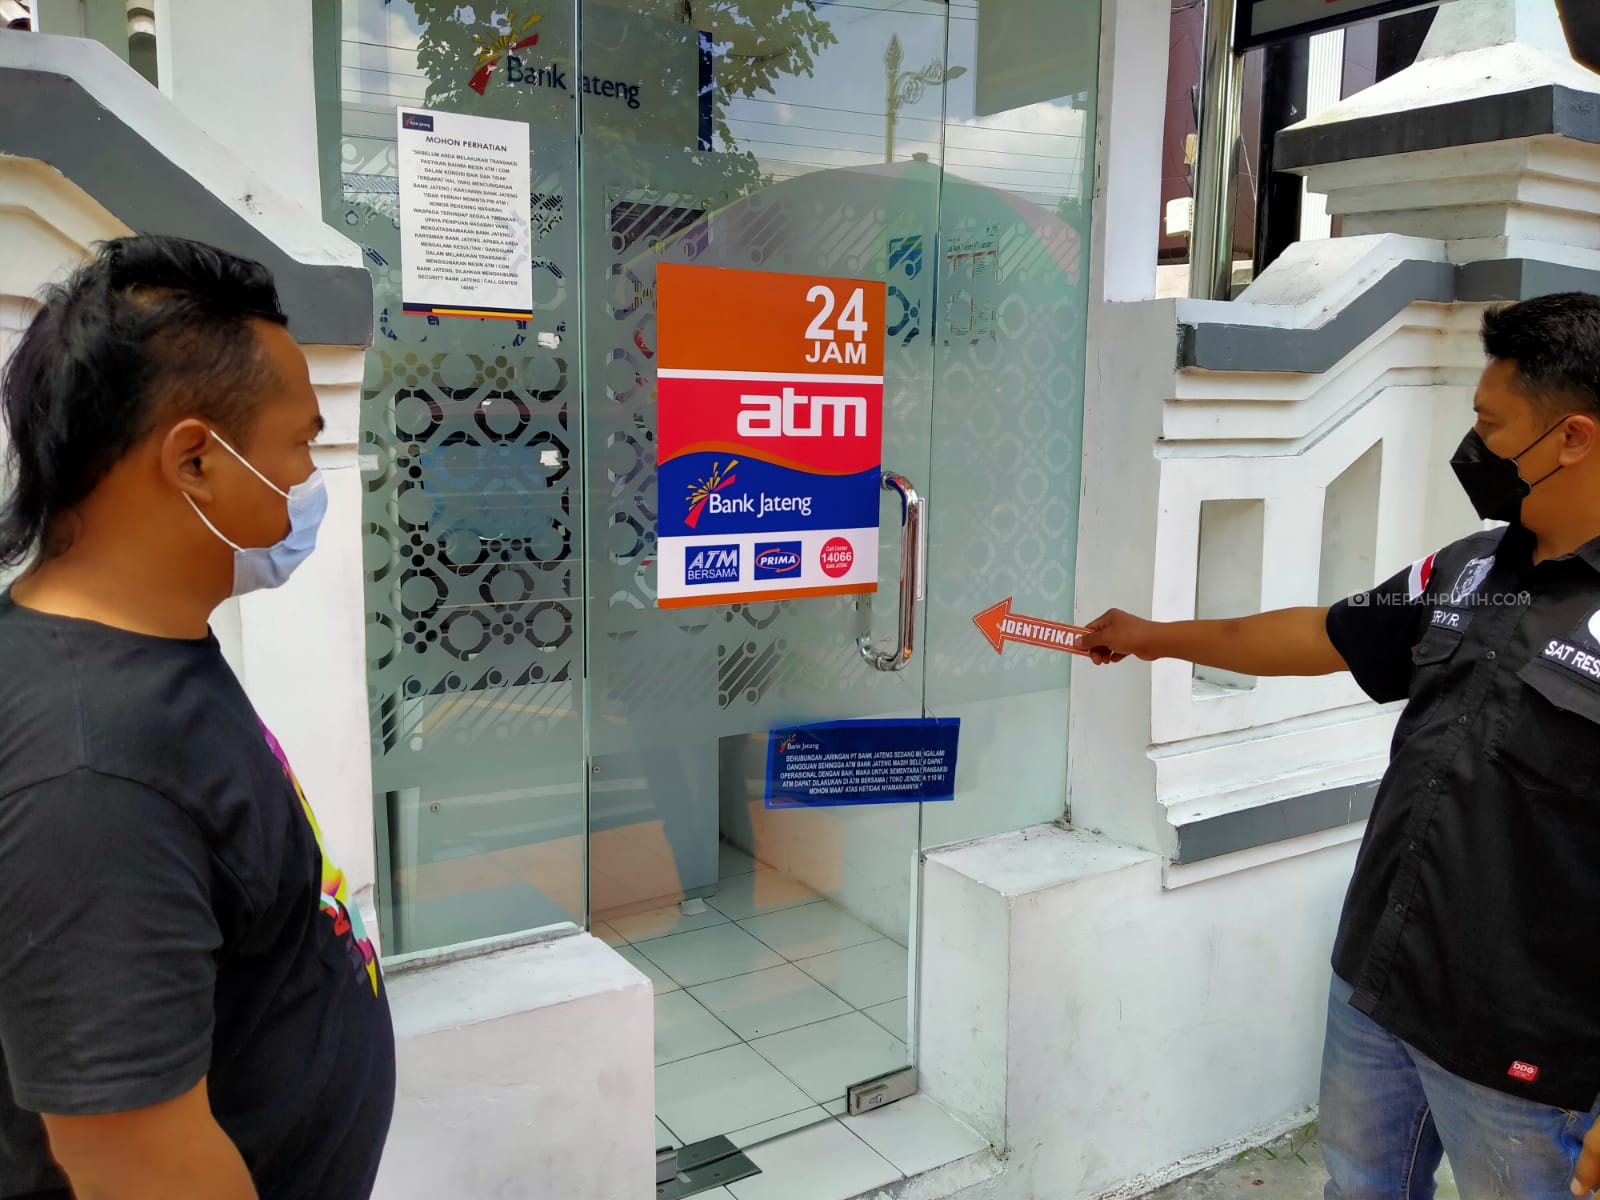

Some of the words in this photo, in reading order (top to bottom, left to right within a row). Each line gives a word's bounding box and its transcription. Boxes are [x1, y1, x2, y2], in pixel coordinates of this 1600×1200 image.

[506, 55, 566, 90] Bank
[571, 74, 640, 109] ateng
[426, 136, 460, 146] MOHON
[463, 140, 507, 152] PERHATIAN
[805, 285, 868, 342] 24
[805, 341, 866, 364] JAM
[736, 388, 867, 437] atm
[709, 493, 754, 514] Bank
[756, 492, 812, 518] Jateng
[688, 550, 738, 570] ATM
[760, 558, 796, 566] PRIMA
[821, 551, 852, 563] 14066
[688, 569, 738, 580] BERSAMA
[1545, 640, 1574, 660] SAT
[1571, 650, 1600, 678] RES
[786, 754, 822, 762] SEHUBUNGAN
[786, 762, 817, 770] GANGGUAN
[780, 771, 817, 779] OPERASIONAL
[890, 767, 920, 775] SEMENTARA
[812, 778, 842, 786] DILAKUKAN
